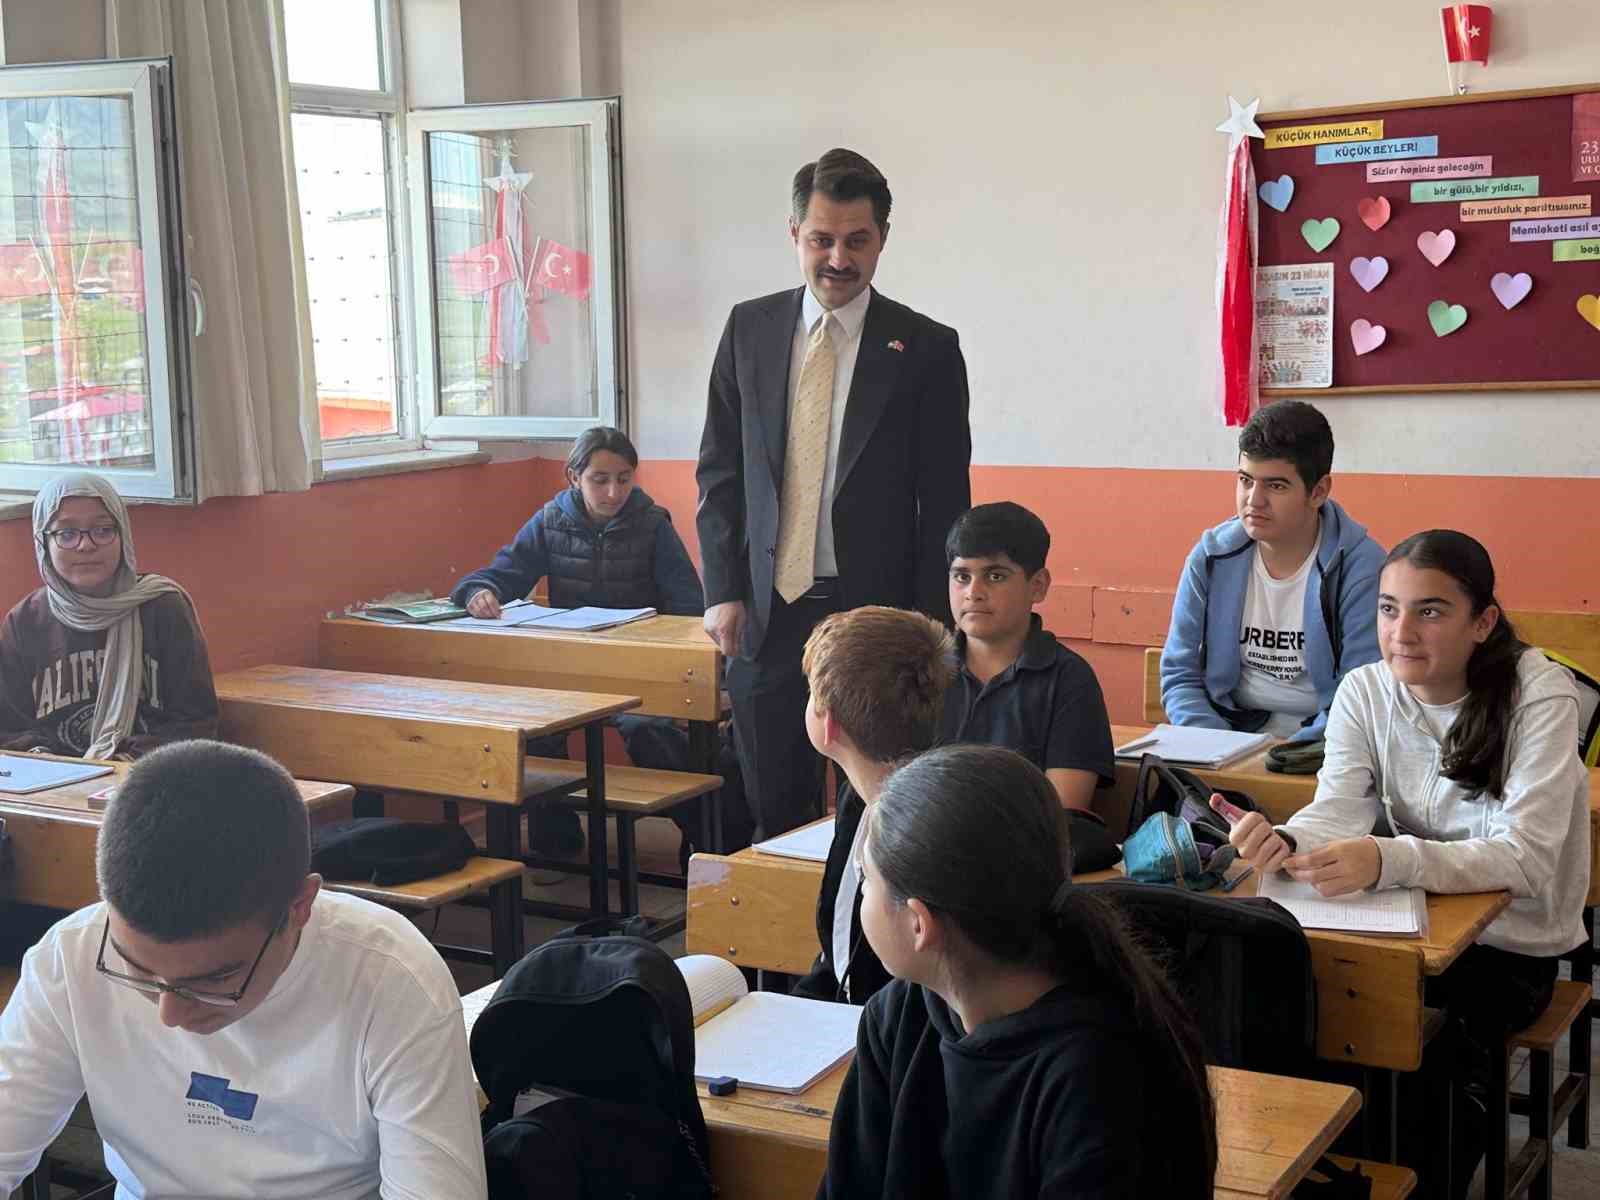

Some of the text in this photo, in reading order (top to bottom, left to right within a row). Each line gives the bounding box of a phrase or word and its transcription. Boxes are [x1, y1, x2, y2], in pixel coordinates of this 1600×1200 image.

[1276, 126, 1372, 143] KÜÇÜK HANIMLAR,
[1335, 145, 1371, 158] KÜÇÜK
[1581, 141, 1599, 153] 23
[1372, 167, 1398, 176] Sizler
[1400, 164, 1435, 175] hepiniz
[1434, 186, 1447, 195] bir
[1462, 207, 1475, 216] bir
[1477, 205, 1521, 215] mutluluk
[1511, 223, 1567, 235] Memleketi
